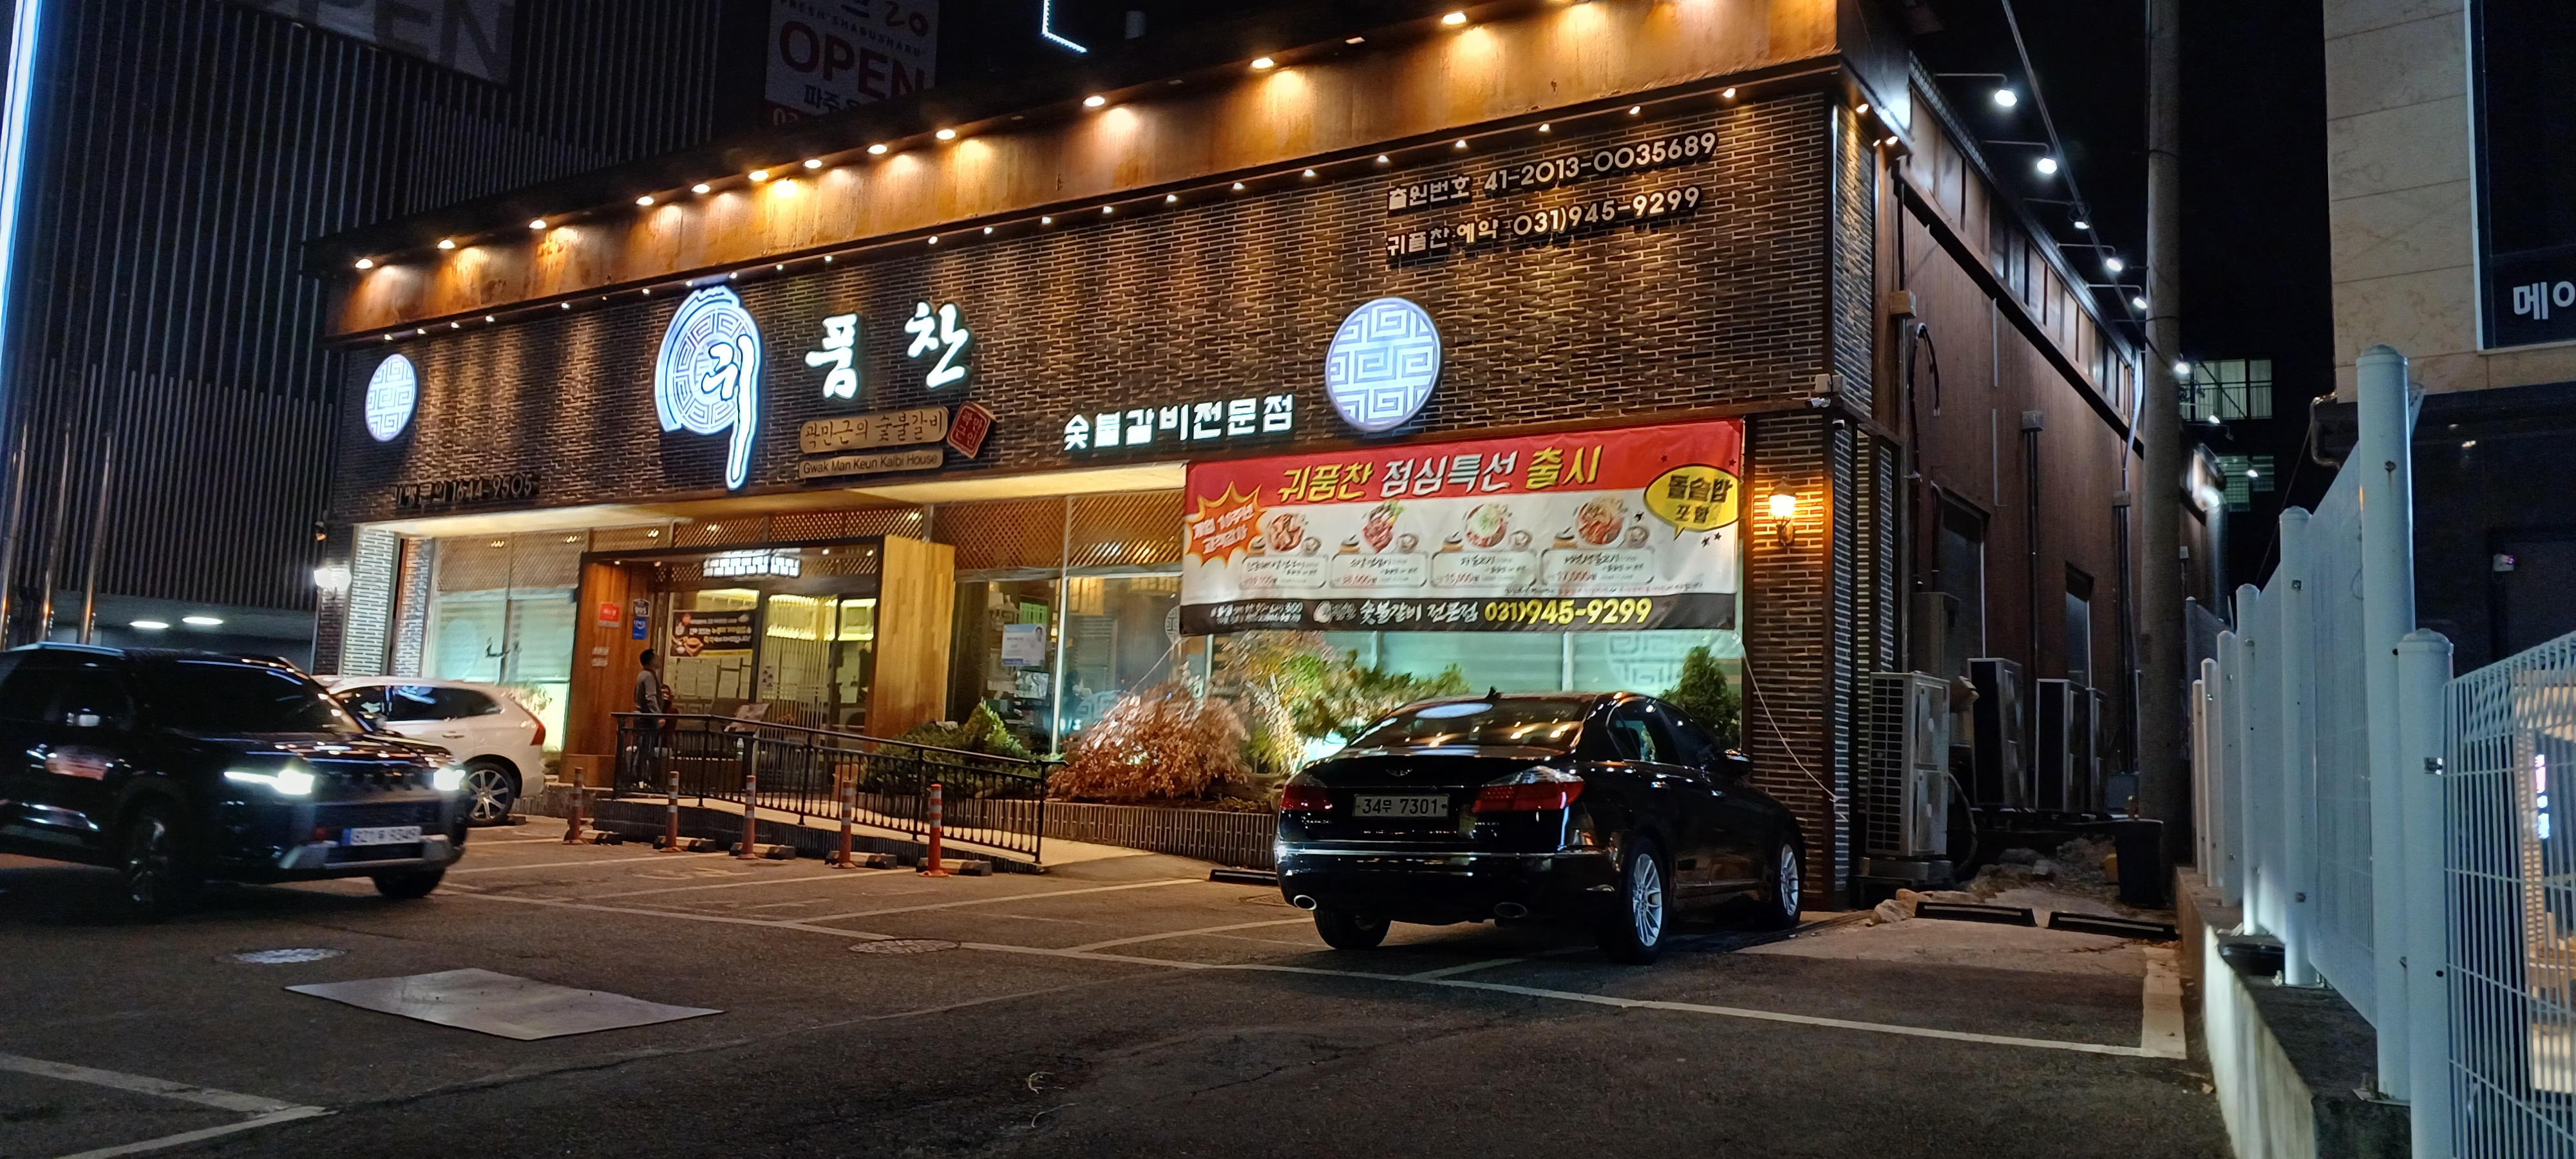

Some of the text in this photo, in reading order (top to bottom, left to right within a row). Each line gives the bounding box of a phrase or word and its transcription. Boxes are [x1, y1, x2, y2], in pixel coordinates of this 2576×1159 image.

[779, 20, 925, 101] OPEN
[1388, 133, 1718, 212] 출원번호 41-2013-0035689
[1387, 187, 1700, 256] 귀품찬 예약 031)945-9299
[875, 410, 943, 441] 숯불갈비
[1064, 394, 1294, 451] 숯불갈비전문점
[803, 452, 938, 474] Gwak Man Keun Kalbi House
[1277, 444, 1604, 503] 귀품찬 점심특선 출시
[1360, 599, 1422, 625] 숯불갈비
[1426, 600, 1479, 624] 전문점
[1484, 598, 1653, 625] 031)945-9299
[1362, 798, 1437, 815] 34무 7301
